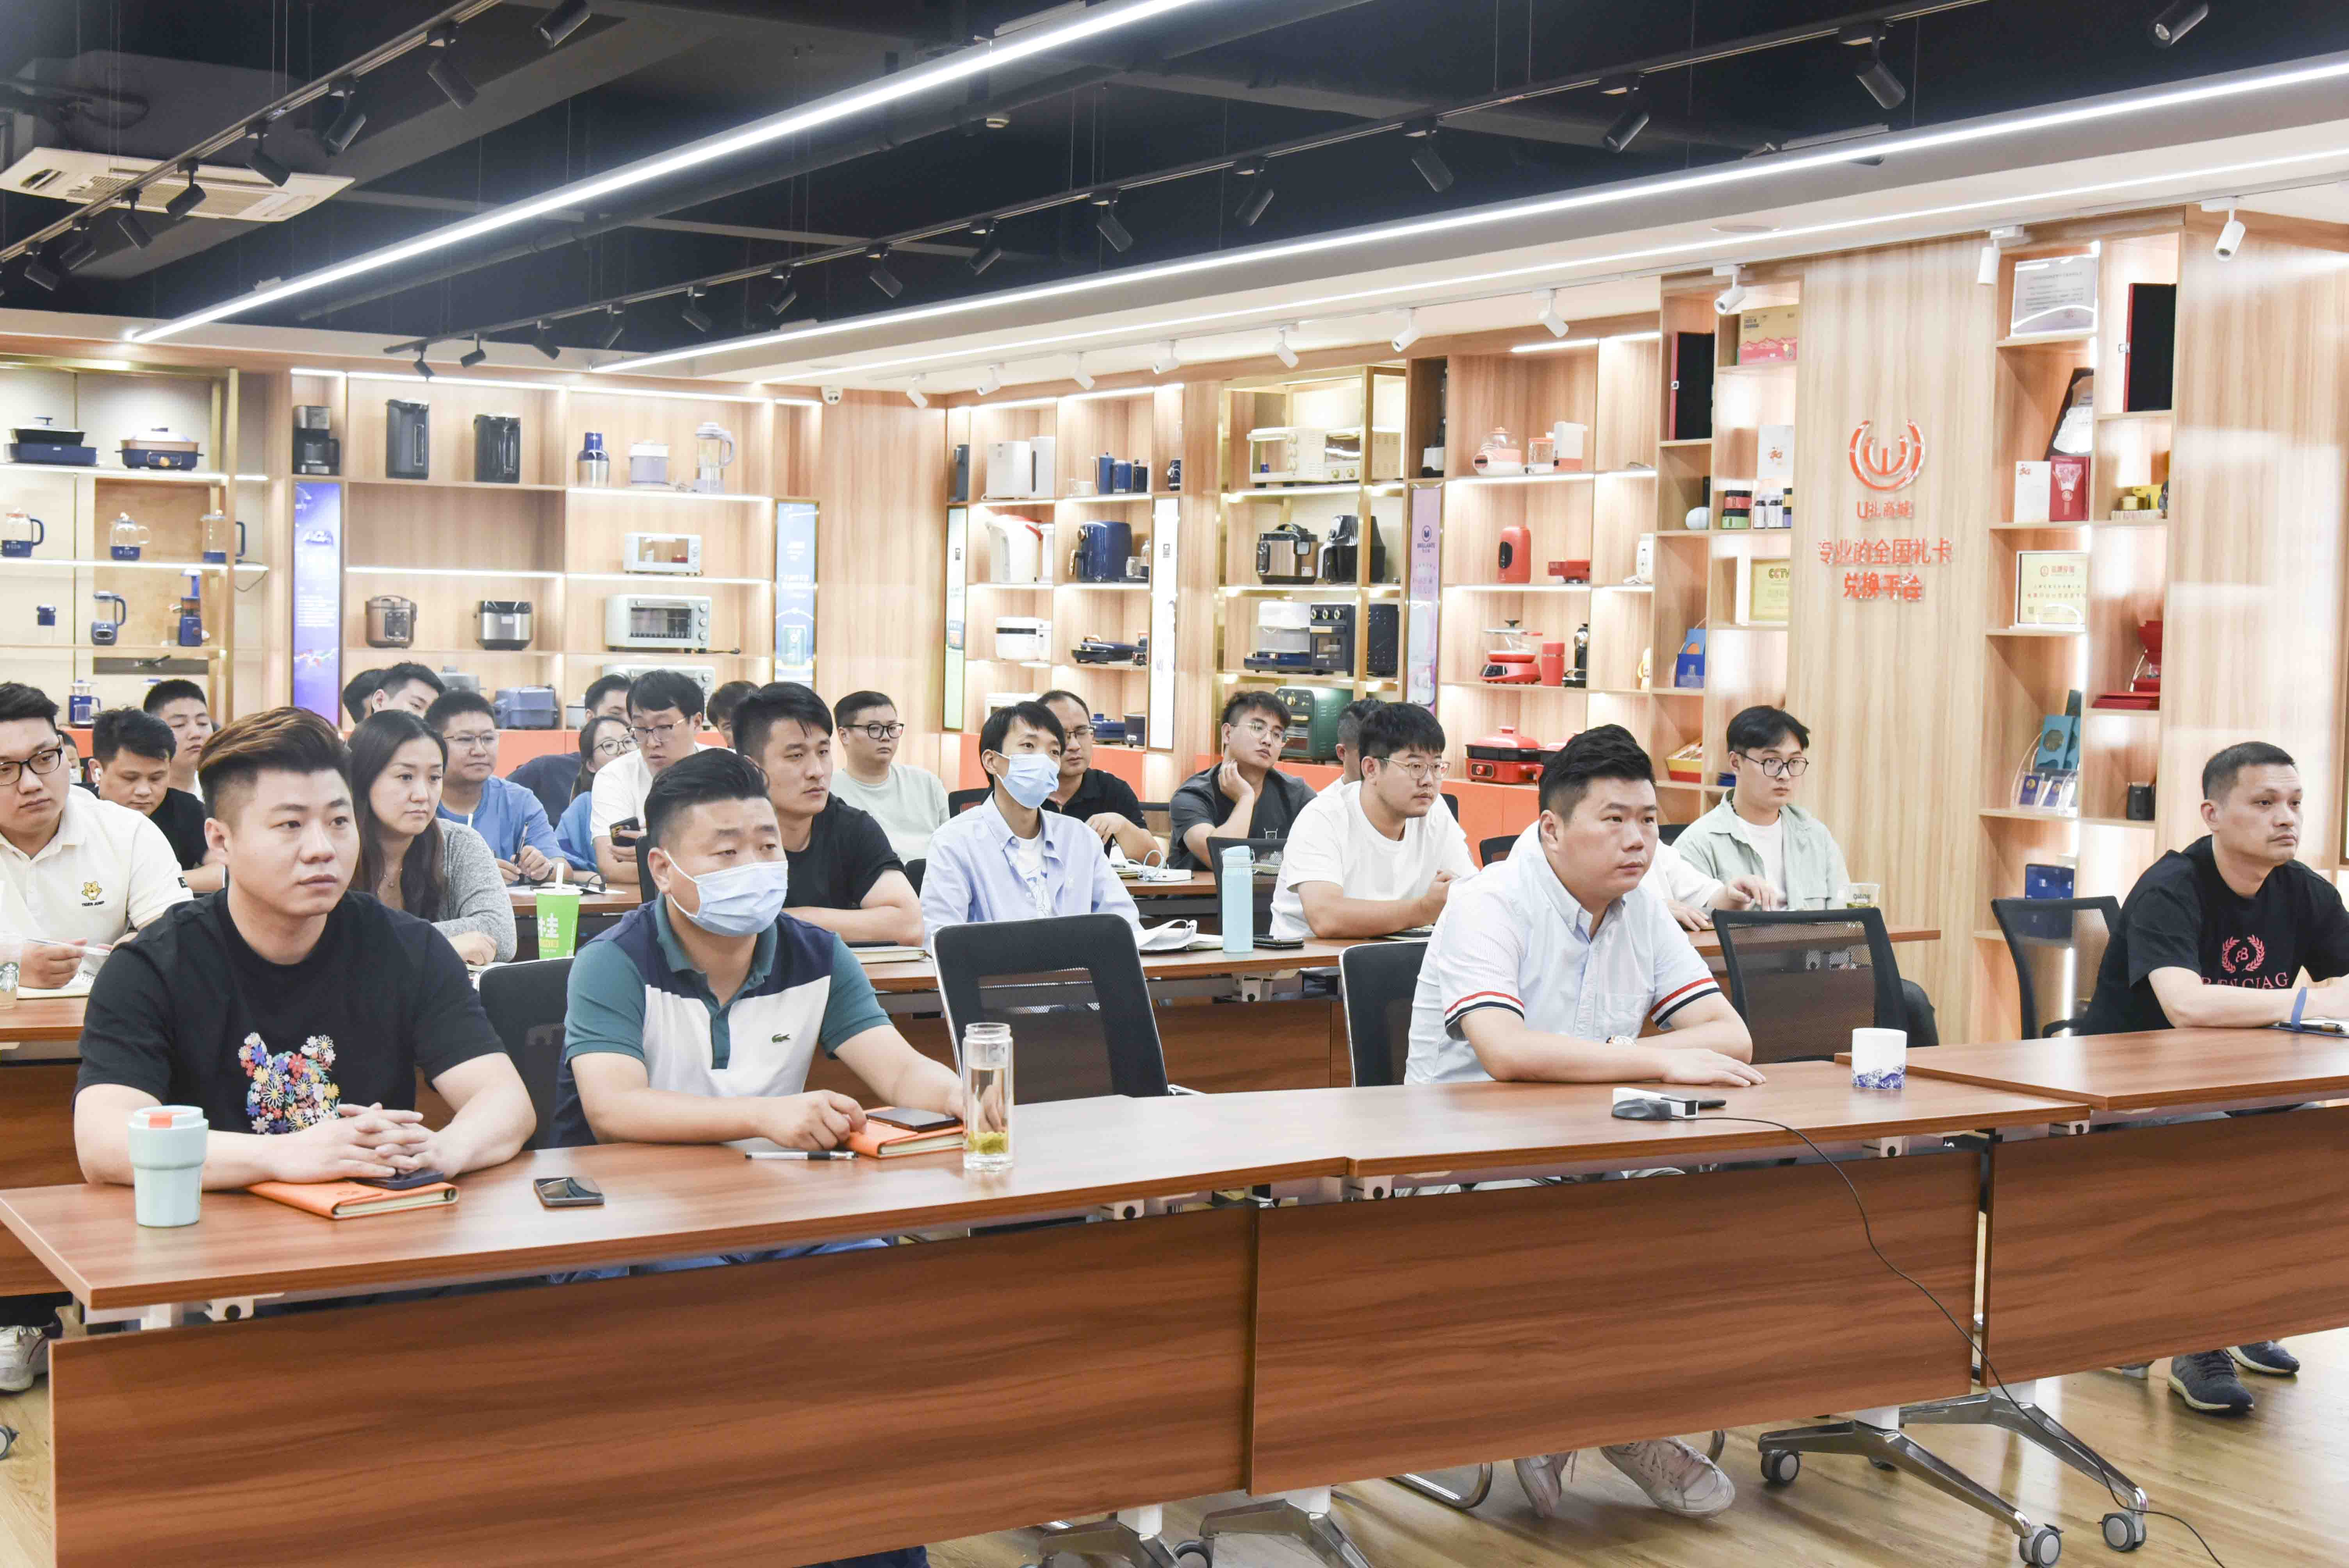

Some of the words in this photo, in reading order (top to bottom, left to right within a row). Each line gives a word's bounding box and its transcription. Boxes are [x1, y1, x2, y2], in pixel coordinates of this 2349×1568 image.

[1818, 538, 1953, 564] 专业的全国礼卡
[1843, 572, 1923, 603] 兑换平台
